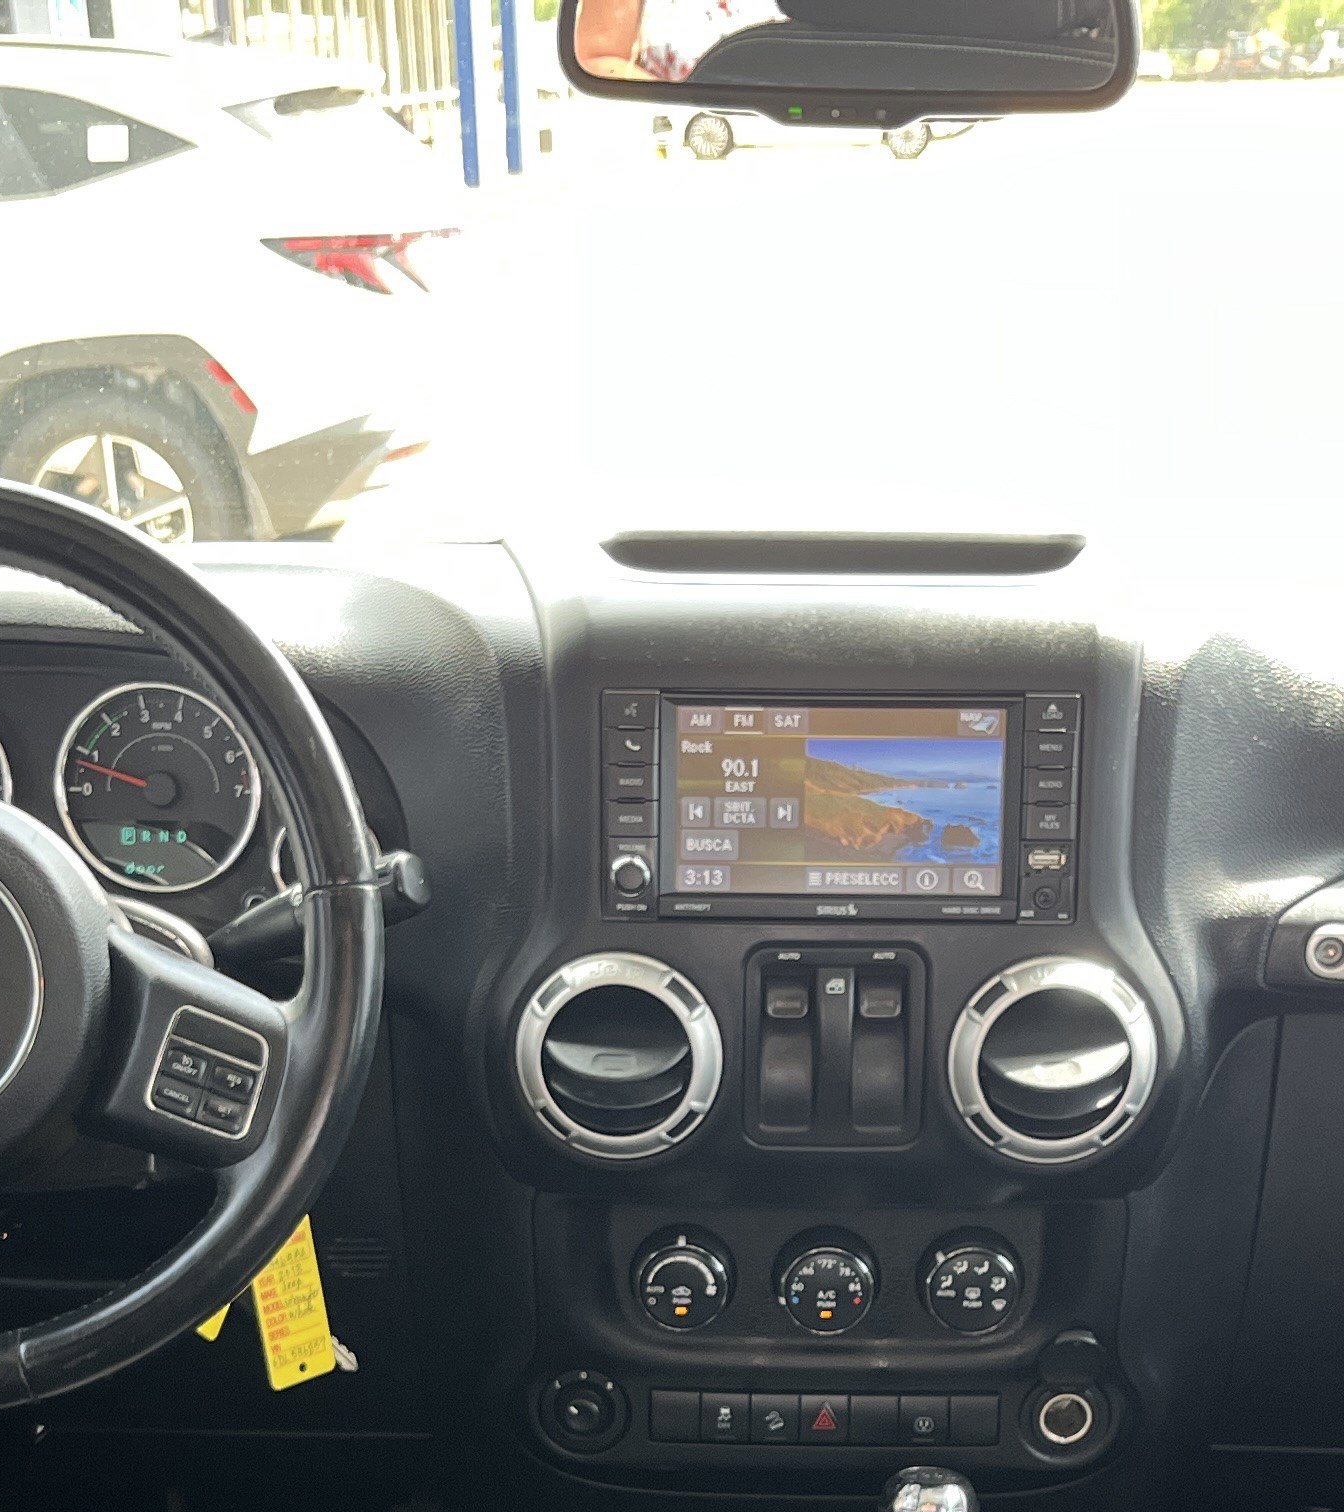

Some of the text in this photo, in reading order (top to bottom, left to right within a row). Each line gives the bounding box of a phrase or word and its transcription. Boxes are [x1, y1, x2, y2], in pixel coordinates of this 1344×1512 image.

[140, 710, 150, 723] 3
[174, 710, 183, 723] 4
[690, 714, 712, 727] AM
[734, 714, 754, 727] FM
[774, 714, 802, 728] SAT
[111, 723, 121, 737] 2
[203, 726, 213, 739] 5
[681, 740, 713, 754] Rock
[90, 750, 99, 763] 1
[225, 751, 236, 765] 6
[721, 758, 759, 777] 90.1
[82, 782, 93, 796] 0
[234, 784, 245, 798] 7
[725, 780, 756, 793] EAST
[142, 830, 151, 842] R
[159, 830, 169, 842] N
[685, 838, 733, 852] BUSCA
[126, 861, 165, 875] door
[684, 869, 723, 886] 3:13
[824, 870, 899, 887] PRESELECC
[817, 1289, 837, 1300] A/C
